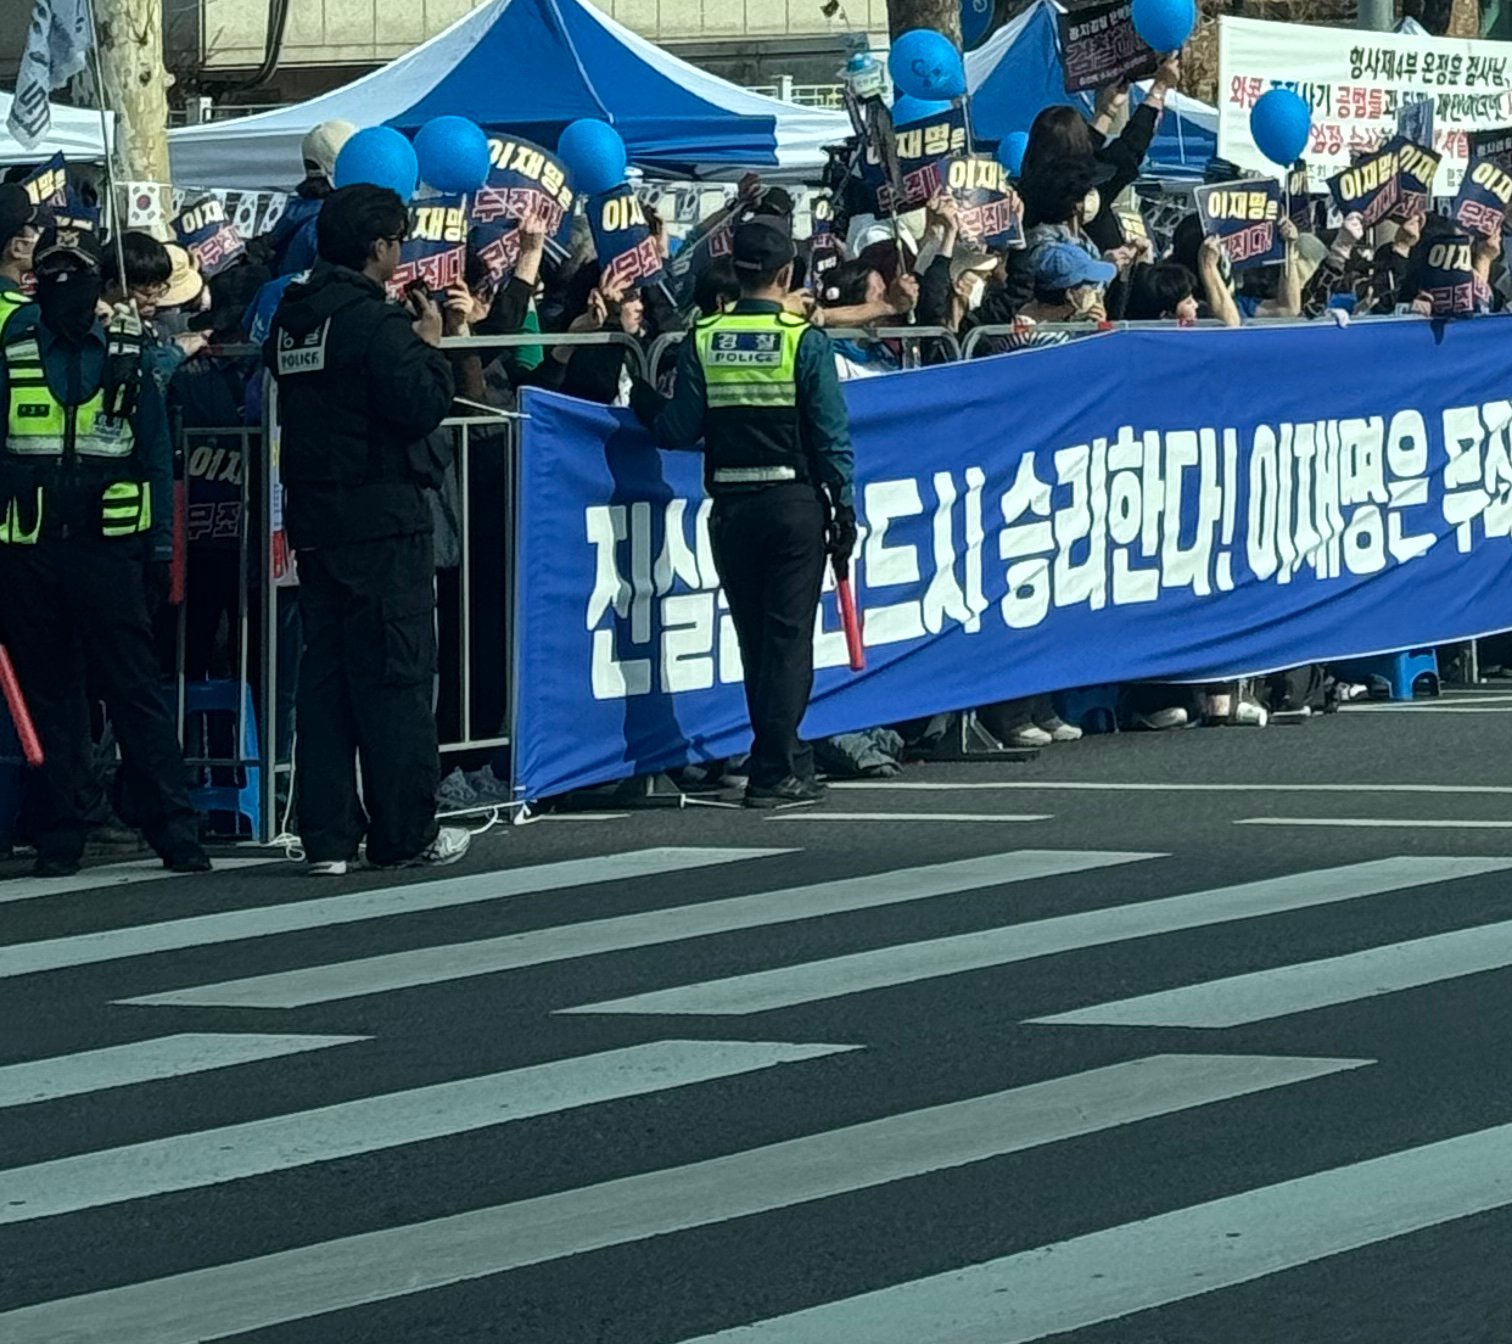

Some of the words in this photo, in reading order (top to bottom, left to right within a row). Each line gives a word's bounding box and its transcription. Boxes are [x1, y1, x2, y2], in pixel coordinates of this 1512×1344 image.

[1349, 46, 1418, 82] 형사제4부
[1208, 191, 1278, 220] 이재명은
[715, 352, 775, 363] POLICE
[1000, 425, 1237, 629] 승리한다!
[1247, 409, 1436, 584] 이재명은
